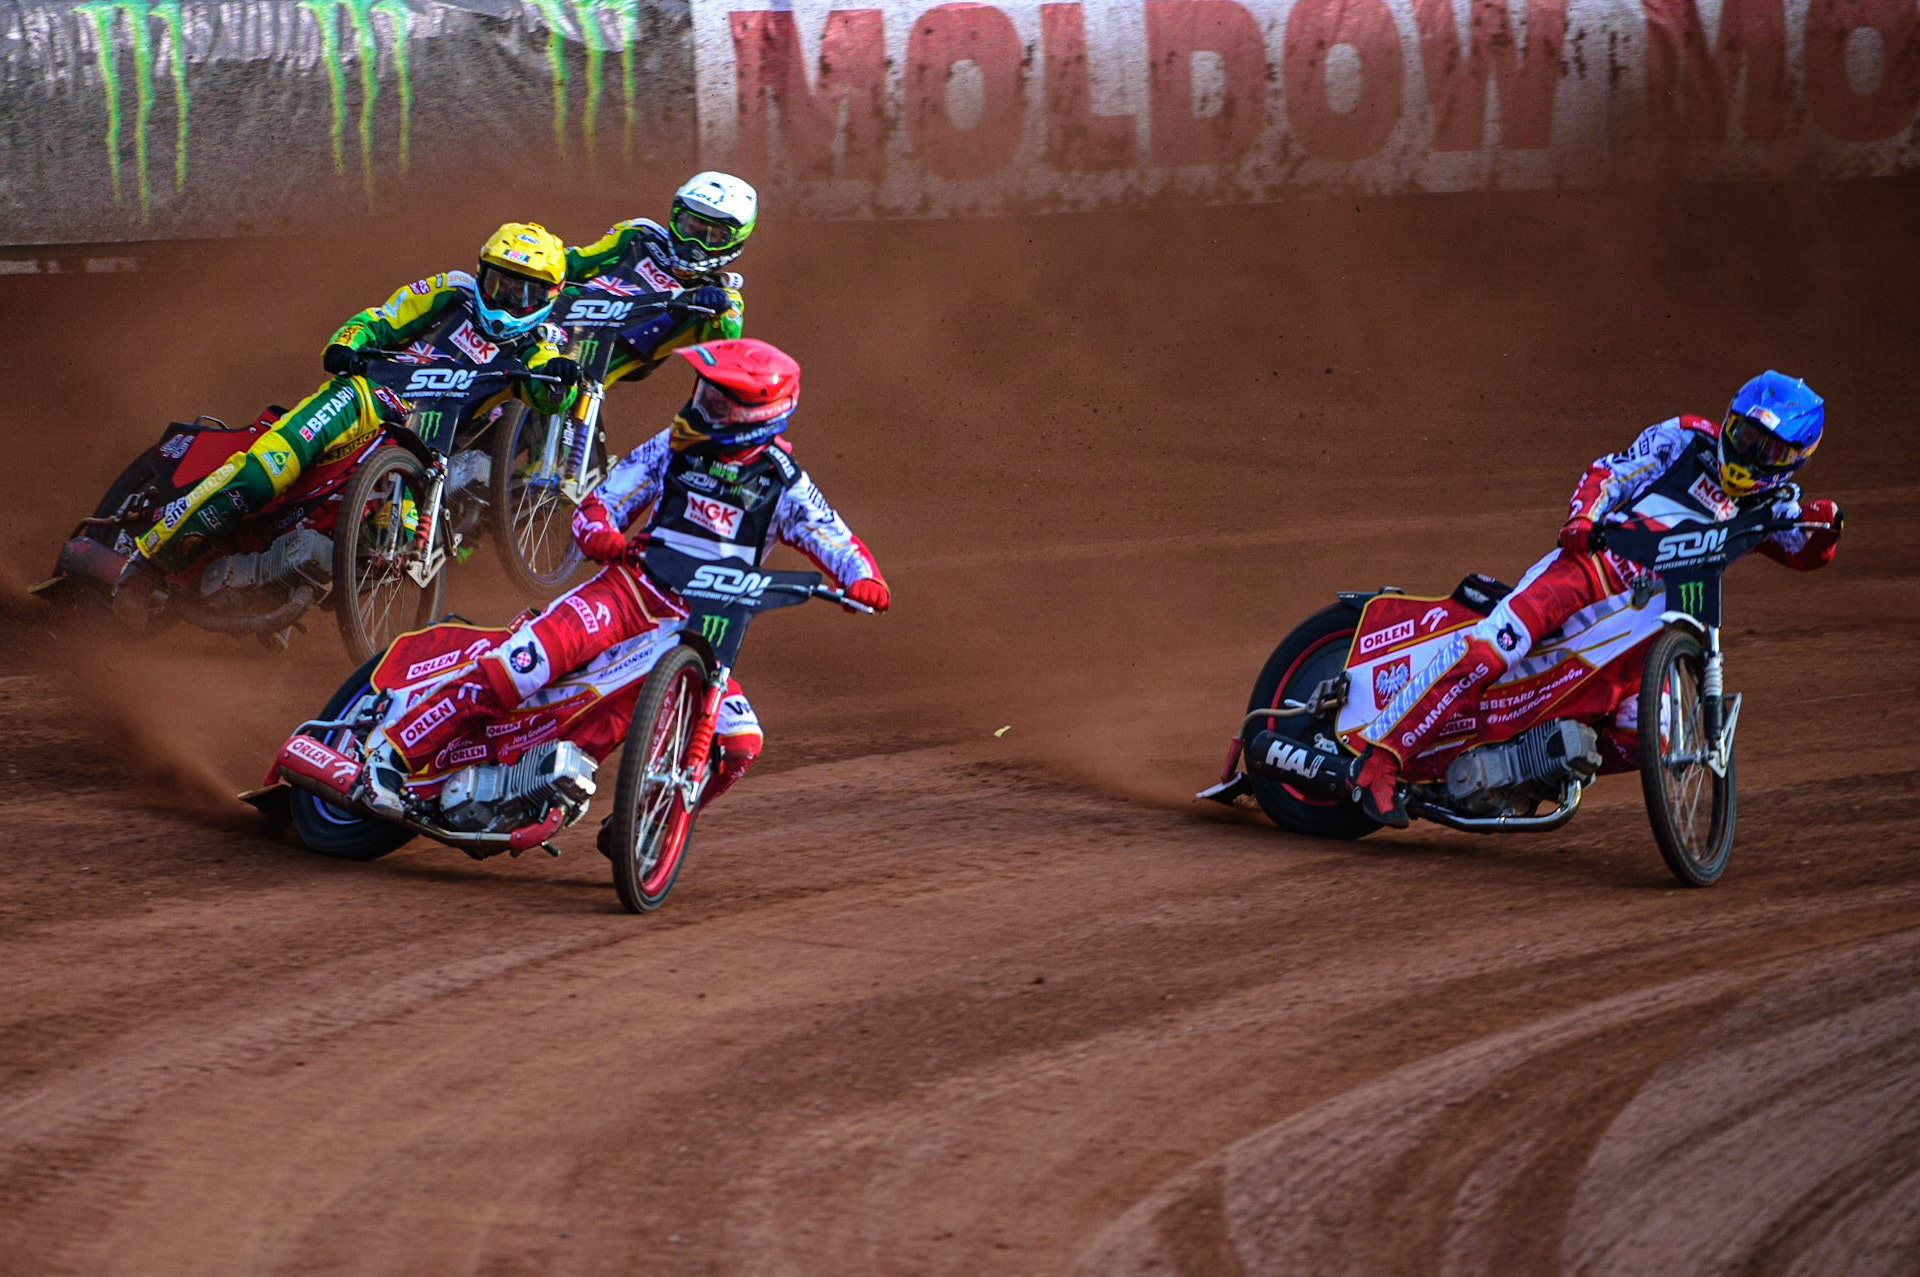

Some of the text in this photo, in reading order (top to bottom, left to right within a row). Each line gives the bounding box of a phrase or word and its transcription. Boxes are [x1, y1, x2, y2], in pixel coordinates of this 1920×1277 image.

[641, 260, 681, 292] NGK
[458, 323, 496, 360] NGK
[405, 368, 478, 391] SDN
[690, 497, 738, 528] NGK
[1655, 527, 1729, 563] SDN
[687, 564, 773, 597] SDN
[1363, 625, 1410, 649] ORLEN
[411, 652, 457, 676] ORLEN
[1414, 662, 1489, 737] IMMERGAS
[1490, 690, 1535, 710] BETARD
[405, 702, 453, 742] ORLEN
[292, 741, 331, 765] ORLEN
[452, 747, 485, 760] ORLEN
